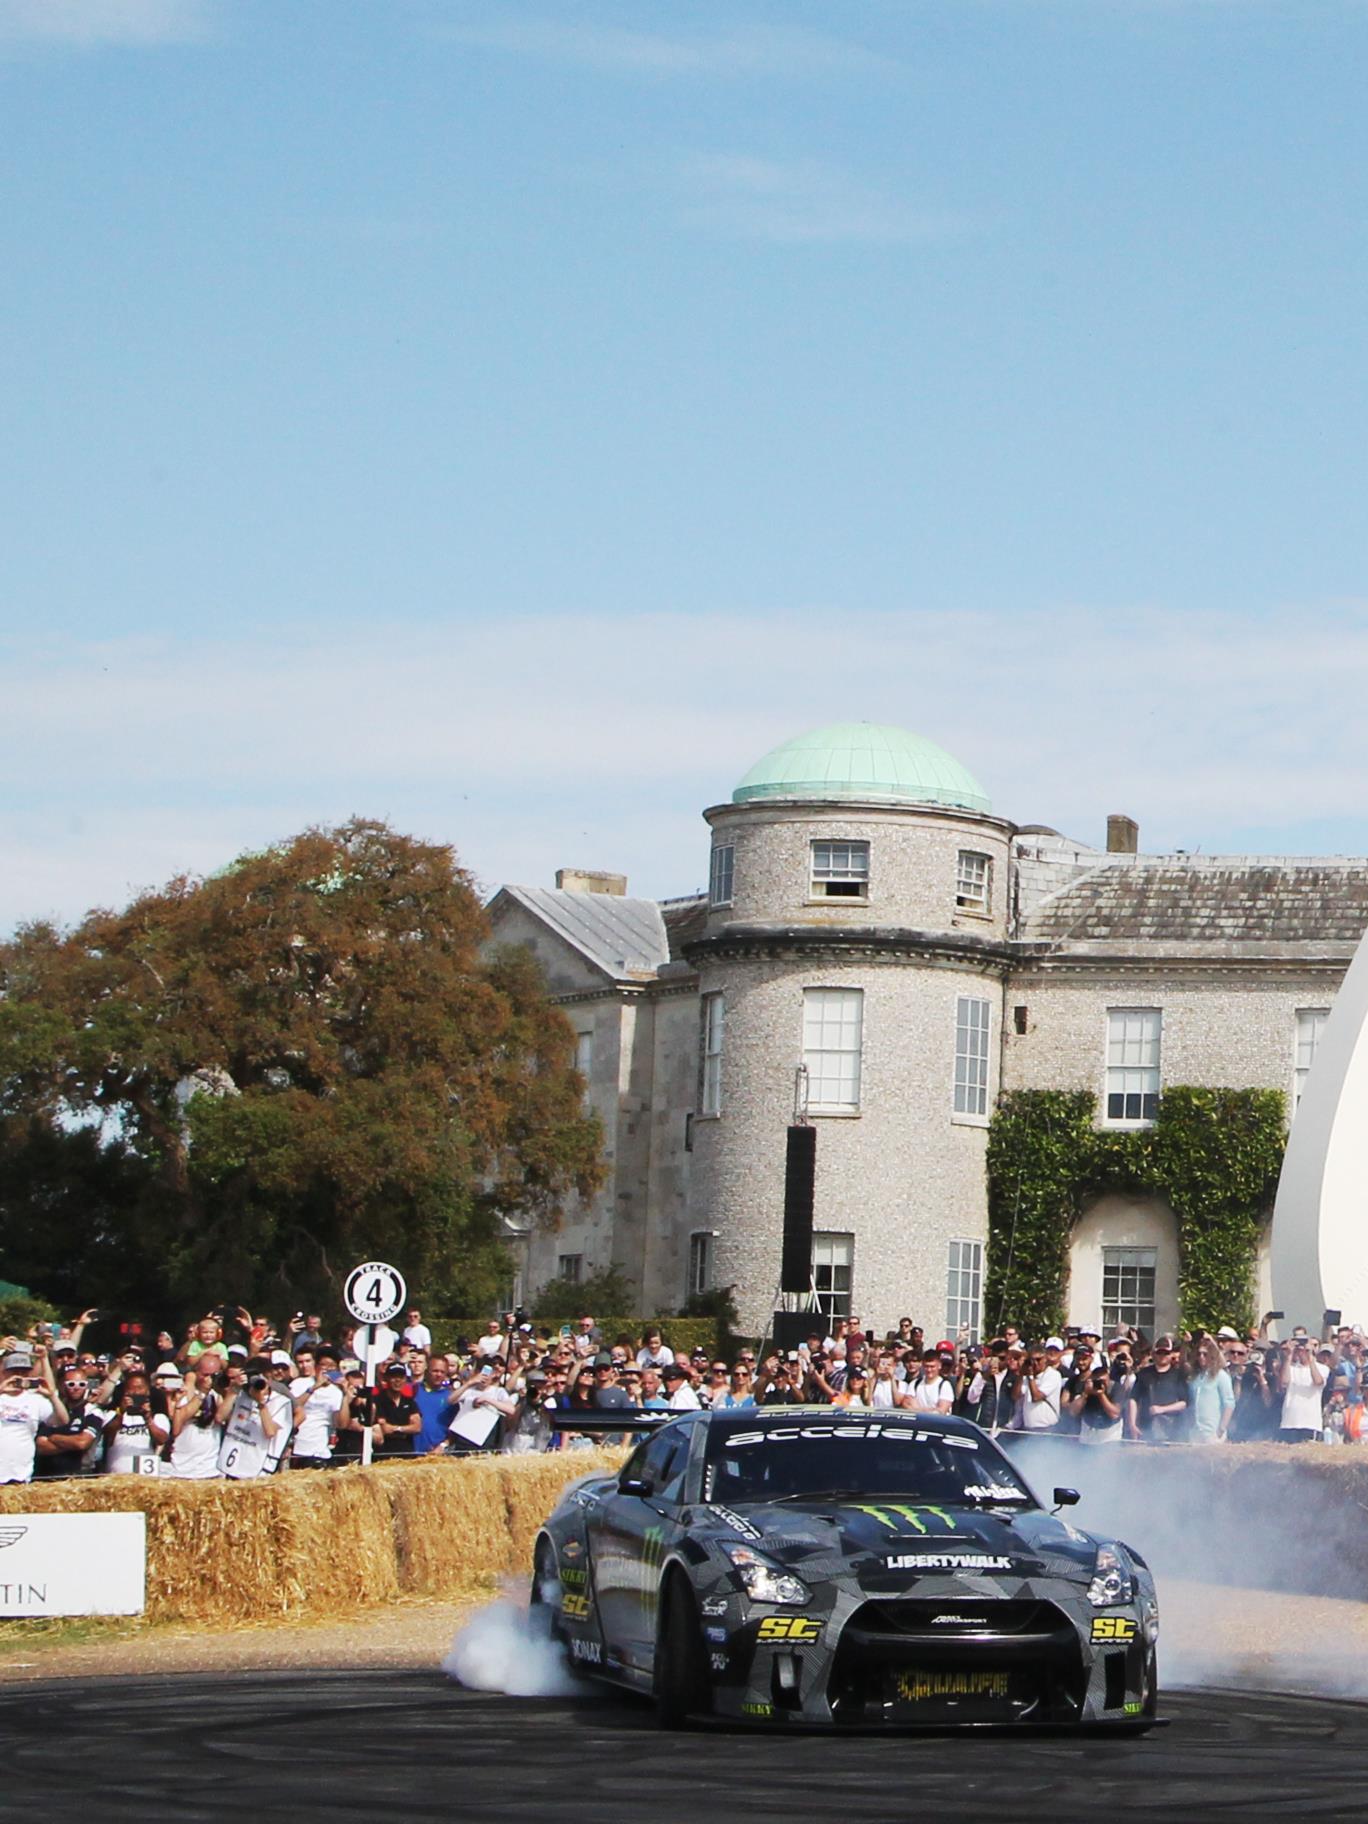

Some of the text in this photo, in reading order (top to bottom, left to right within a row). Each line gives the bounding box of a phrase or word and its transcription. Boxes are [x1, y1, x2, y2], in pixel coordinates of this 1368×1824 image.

[366, 1279, 382, 1307] 4
[725, 1424, 979, 1450] accelera
[144, 1459, 154, 1473] 3
[226, 1448, 238, 1467] 6
[886, 1555, 1012, 1569] LIBERTYWALK
